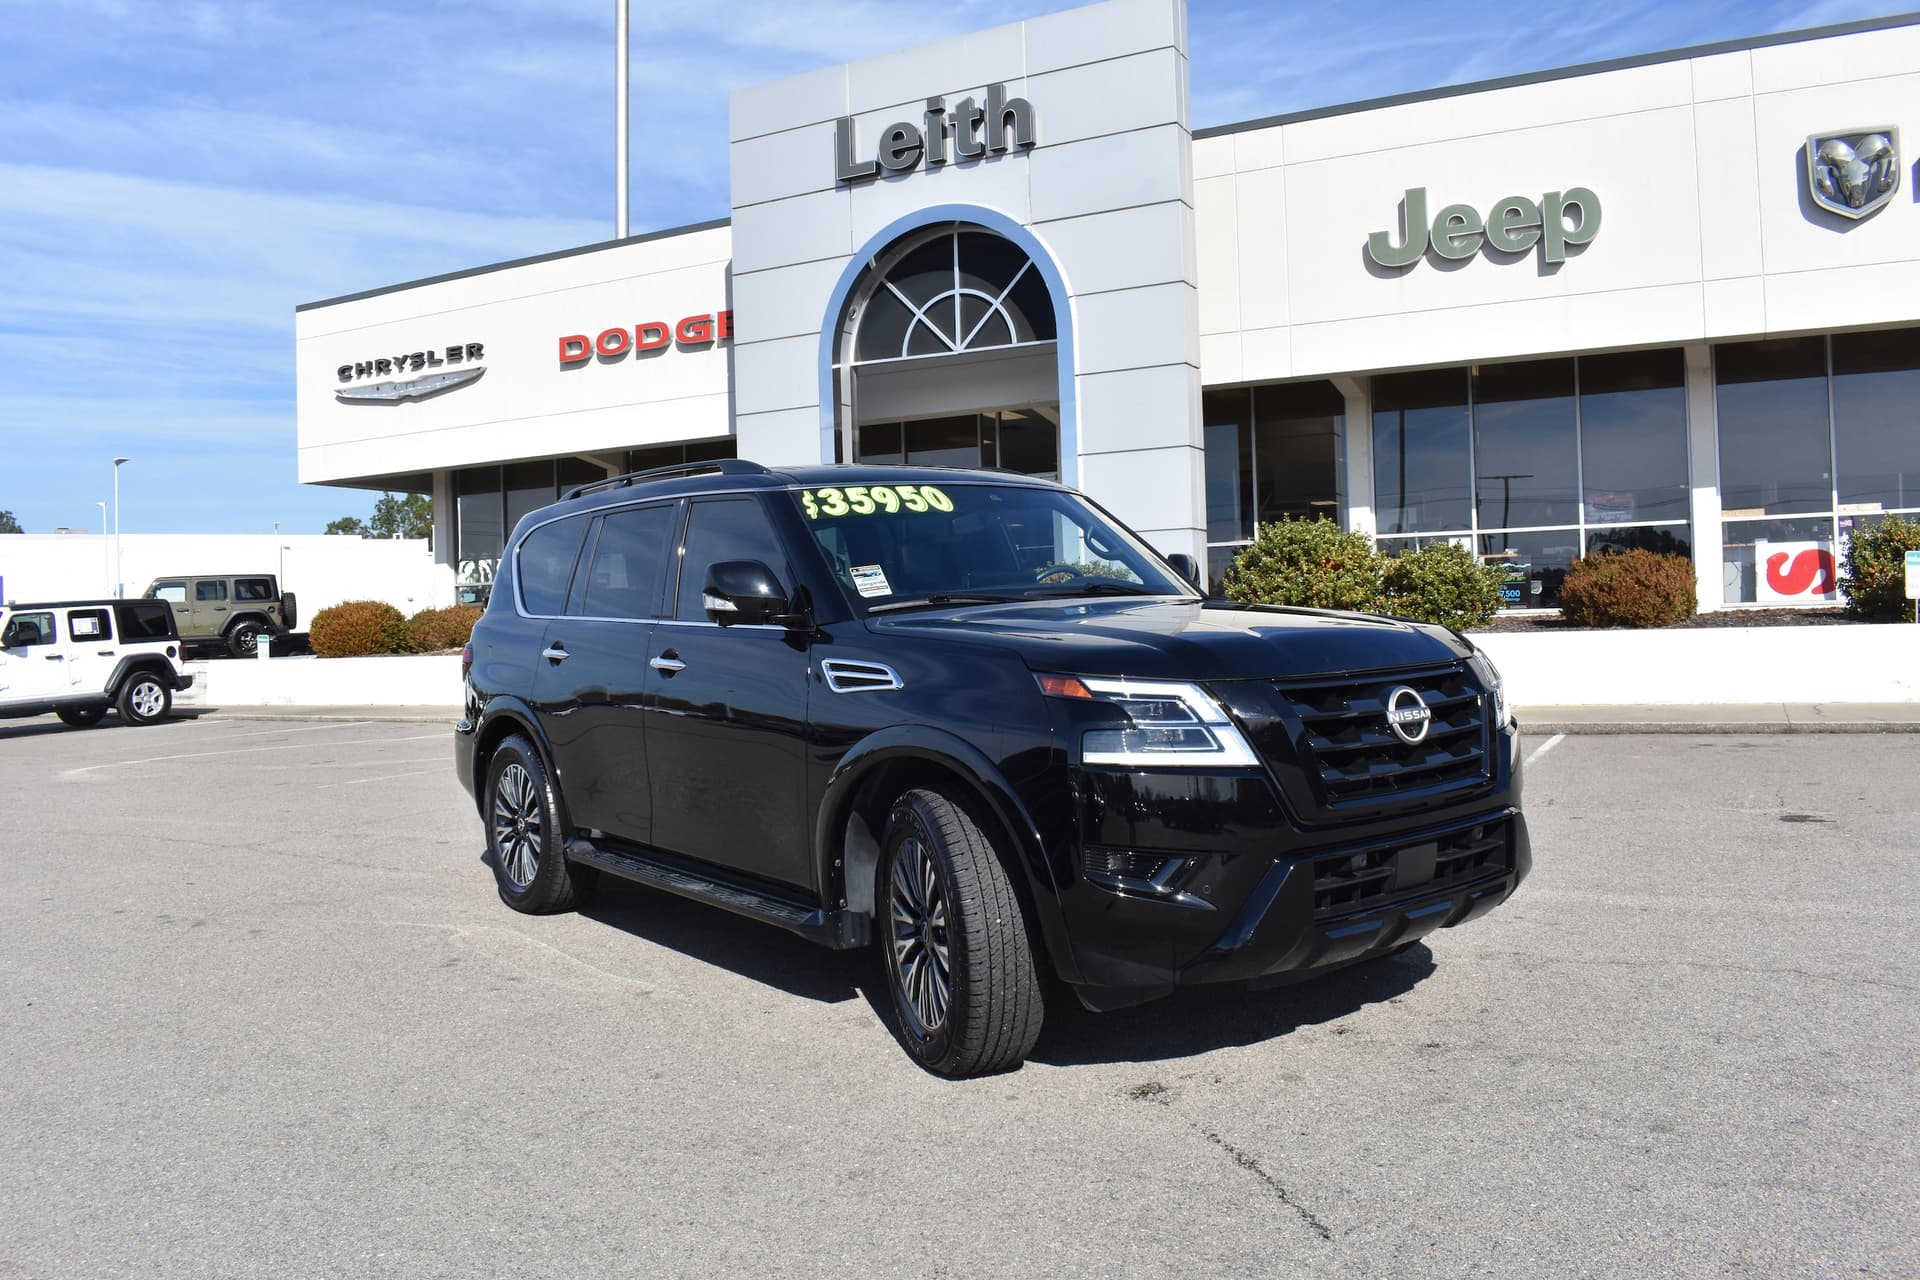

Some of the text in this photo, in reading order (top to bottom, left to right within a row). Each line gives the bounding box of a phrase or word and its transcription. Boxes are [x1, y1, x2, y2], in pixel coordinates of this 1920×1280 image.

[836, 84, 1035, 182] Leith
[1368, 186, 1602, 266] Jeep
[337, 343, 484, 381] CHRYSLER
[802, 486, 954, 519] $35950
[1390, 709, 1430, 722] NISSAN
